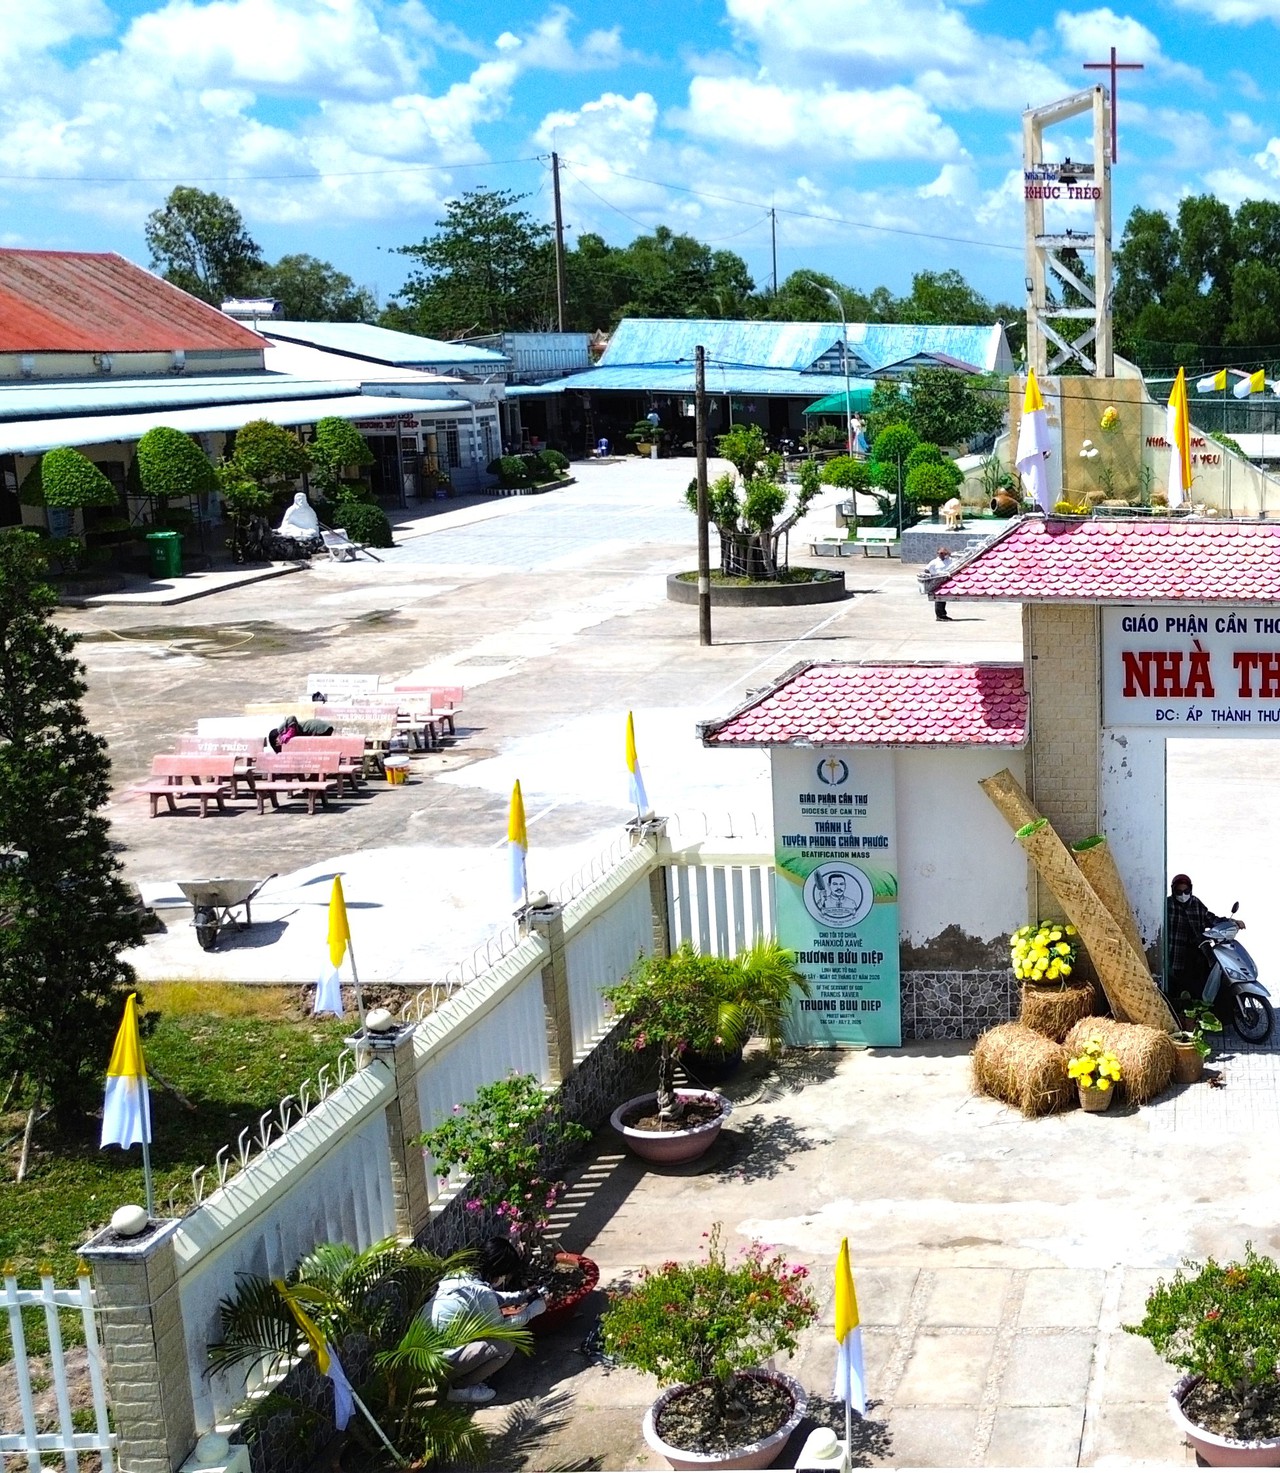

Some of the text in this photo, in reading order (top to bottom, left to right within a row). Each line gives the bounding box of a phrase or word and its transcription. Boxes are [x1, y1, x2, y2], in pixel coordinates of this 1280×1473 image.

[1025, 182, 1101, 200] KHÚC TRÉO
[1122, 614, 1158, 633] GIÁO
[1166, 614, 1208, 636] PHẬN
[1215, 612, 1247, 633] CẦN
[1122, 639, 1215, 697] NHÀ
[1156, 709, 1180, 721] ĐC:
[1186, 705, 1202, 722] ẤP
[1211, 706, 1251, 722] THÀNH
[800, 793, 815, 804] GIÁO
[818, 793, 836, 807] PHẬN
[855, 794, 868, 804] THƠ
[815, 820, 841, 833] THÁNH
[782, 834, 888, 848] TUYÊN PHONG CHÂN PHƯỚC
[814, 939, 844, 947] PHANXICÔ
[794, 948, 883, 966] TRƯƠNG BỬU DIỆP
[800, 1000, 881, 1011] TRUONG BUU DIEP
